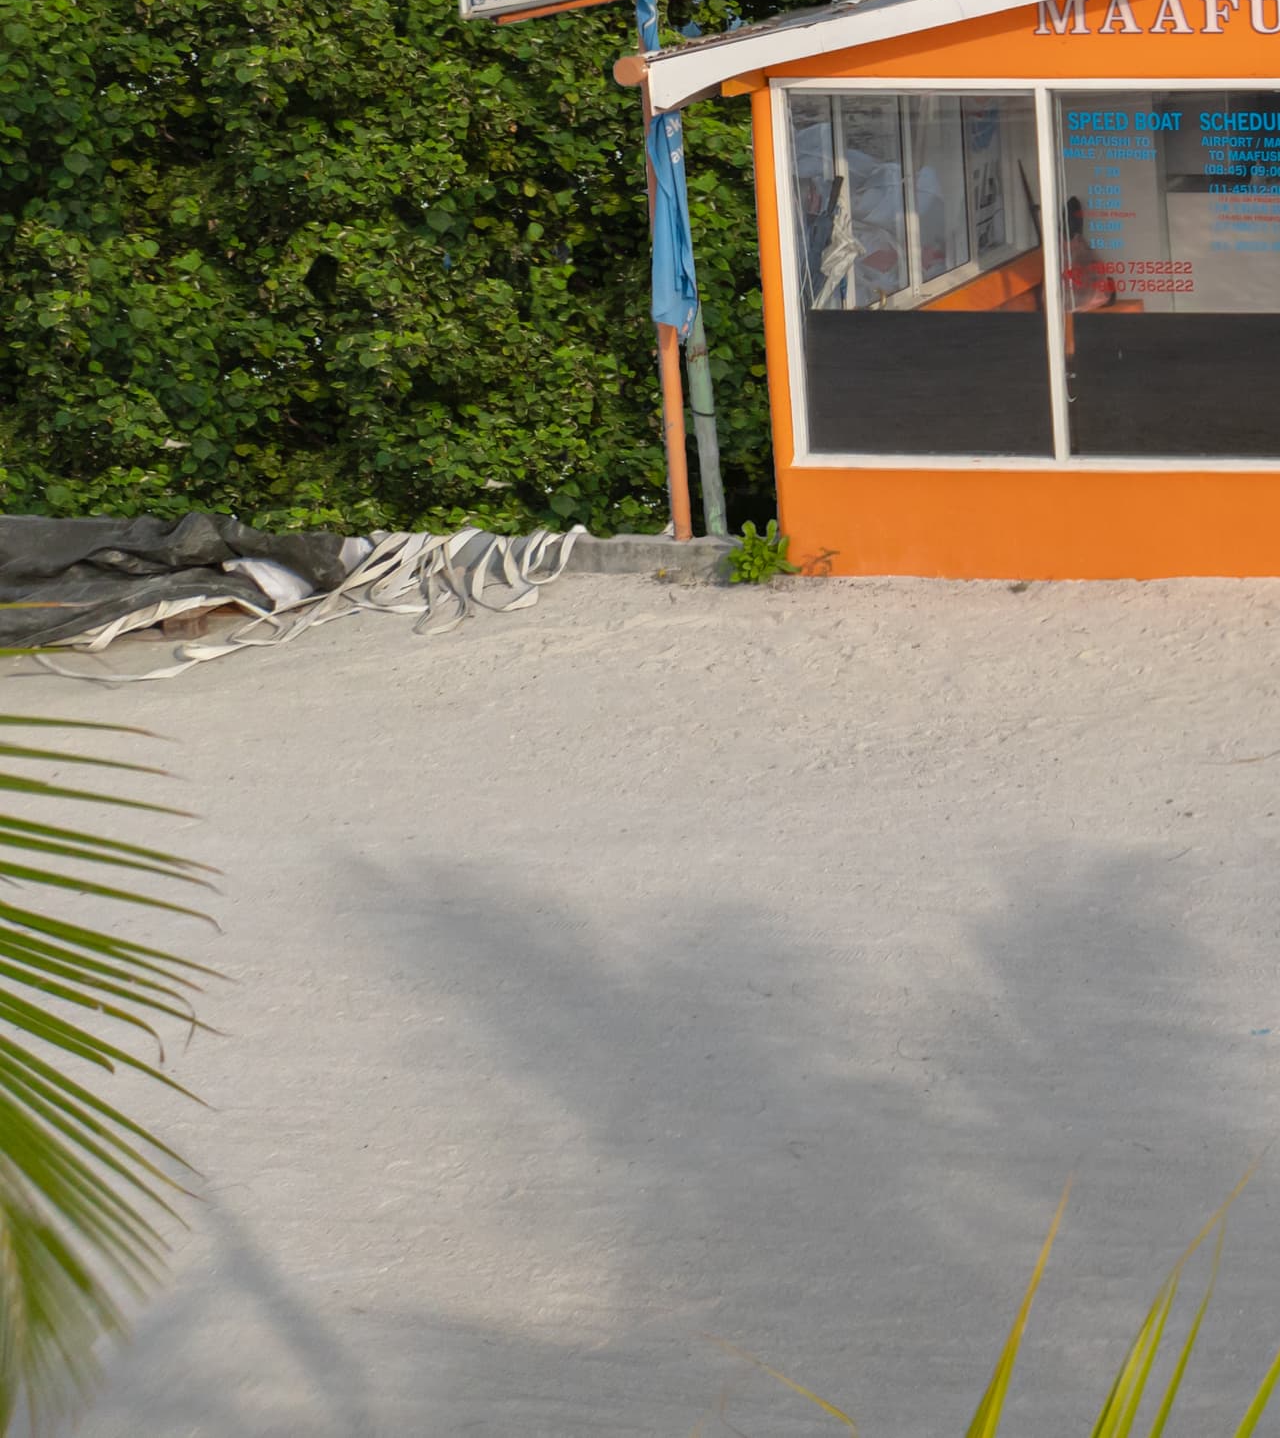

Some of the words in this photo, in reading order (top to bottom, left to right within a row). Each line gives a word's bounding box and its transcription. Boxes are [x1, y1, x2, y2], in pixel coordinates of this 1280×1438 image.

[1067, 111, 1129, 131] SPEED
[1134, 111, 1183, 131] BOAT
[1201, 136, 1254, 148] AIRPORT
[1208, 150, 1225, 161] TO
[1128, 261, 1193, 275] 7352222
[1129, 279, 1194, 293] 7362222
